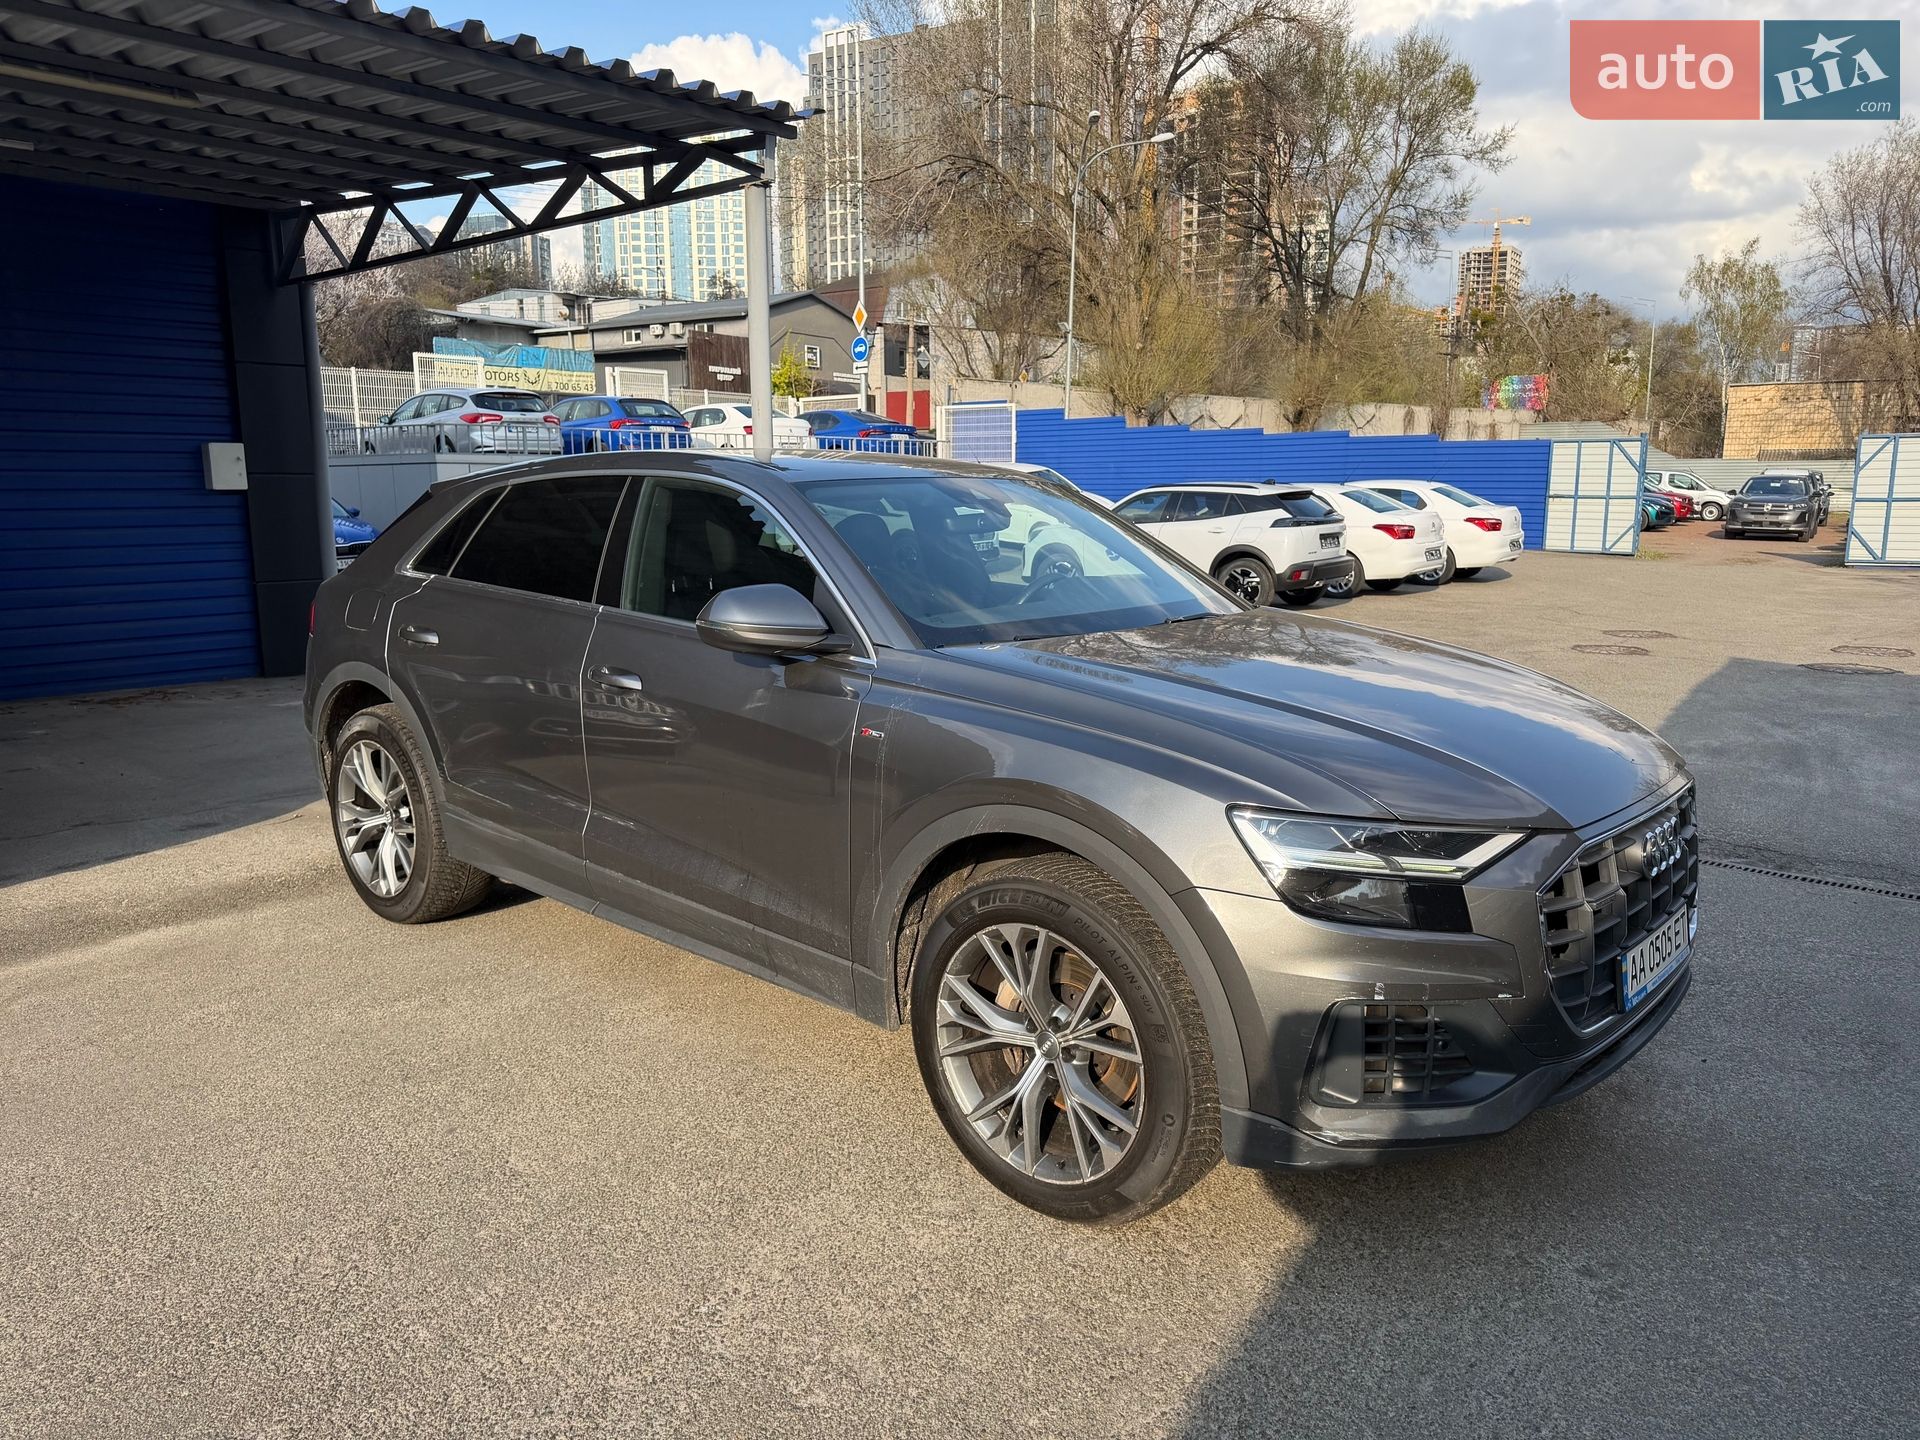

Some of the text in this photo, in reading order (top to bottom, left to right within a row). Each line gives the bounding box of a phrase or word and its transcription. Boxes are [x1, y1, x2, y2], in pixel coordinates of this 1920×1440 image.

[554, 381, 569, 391] 700
[584, 383, 594, 392] 43
[1074, 917, 1107, 944] PILOT
[1107, 949, 1137, 984] ALPIN
[1630, 948, 1647, 991] AA
[1648, 924, 1673, 973] 0505
[1674, 910, 1686, 951] ET
